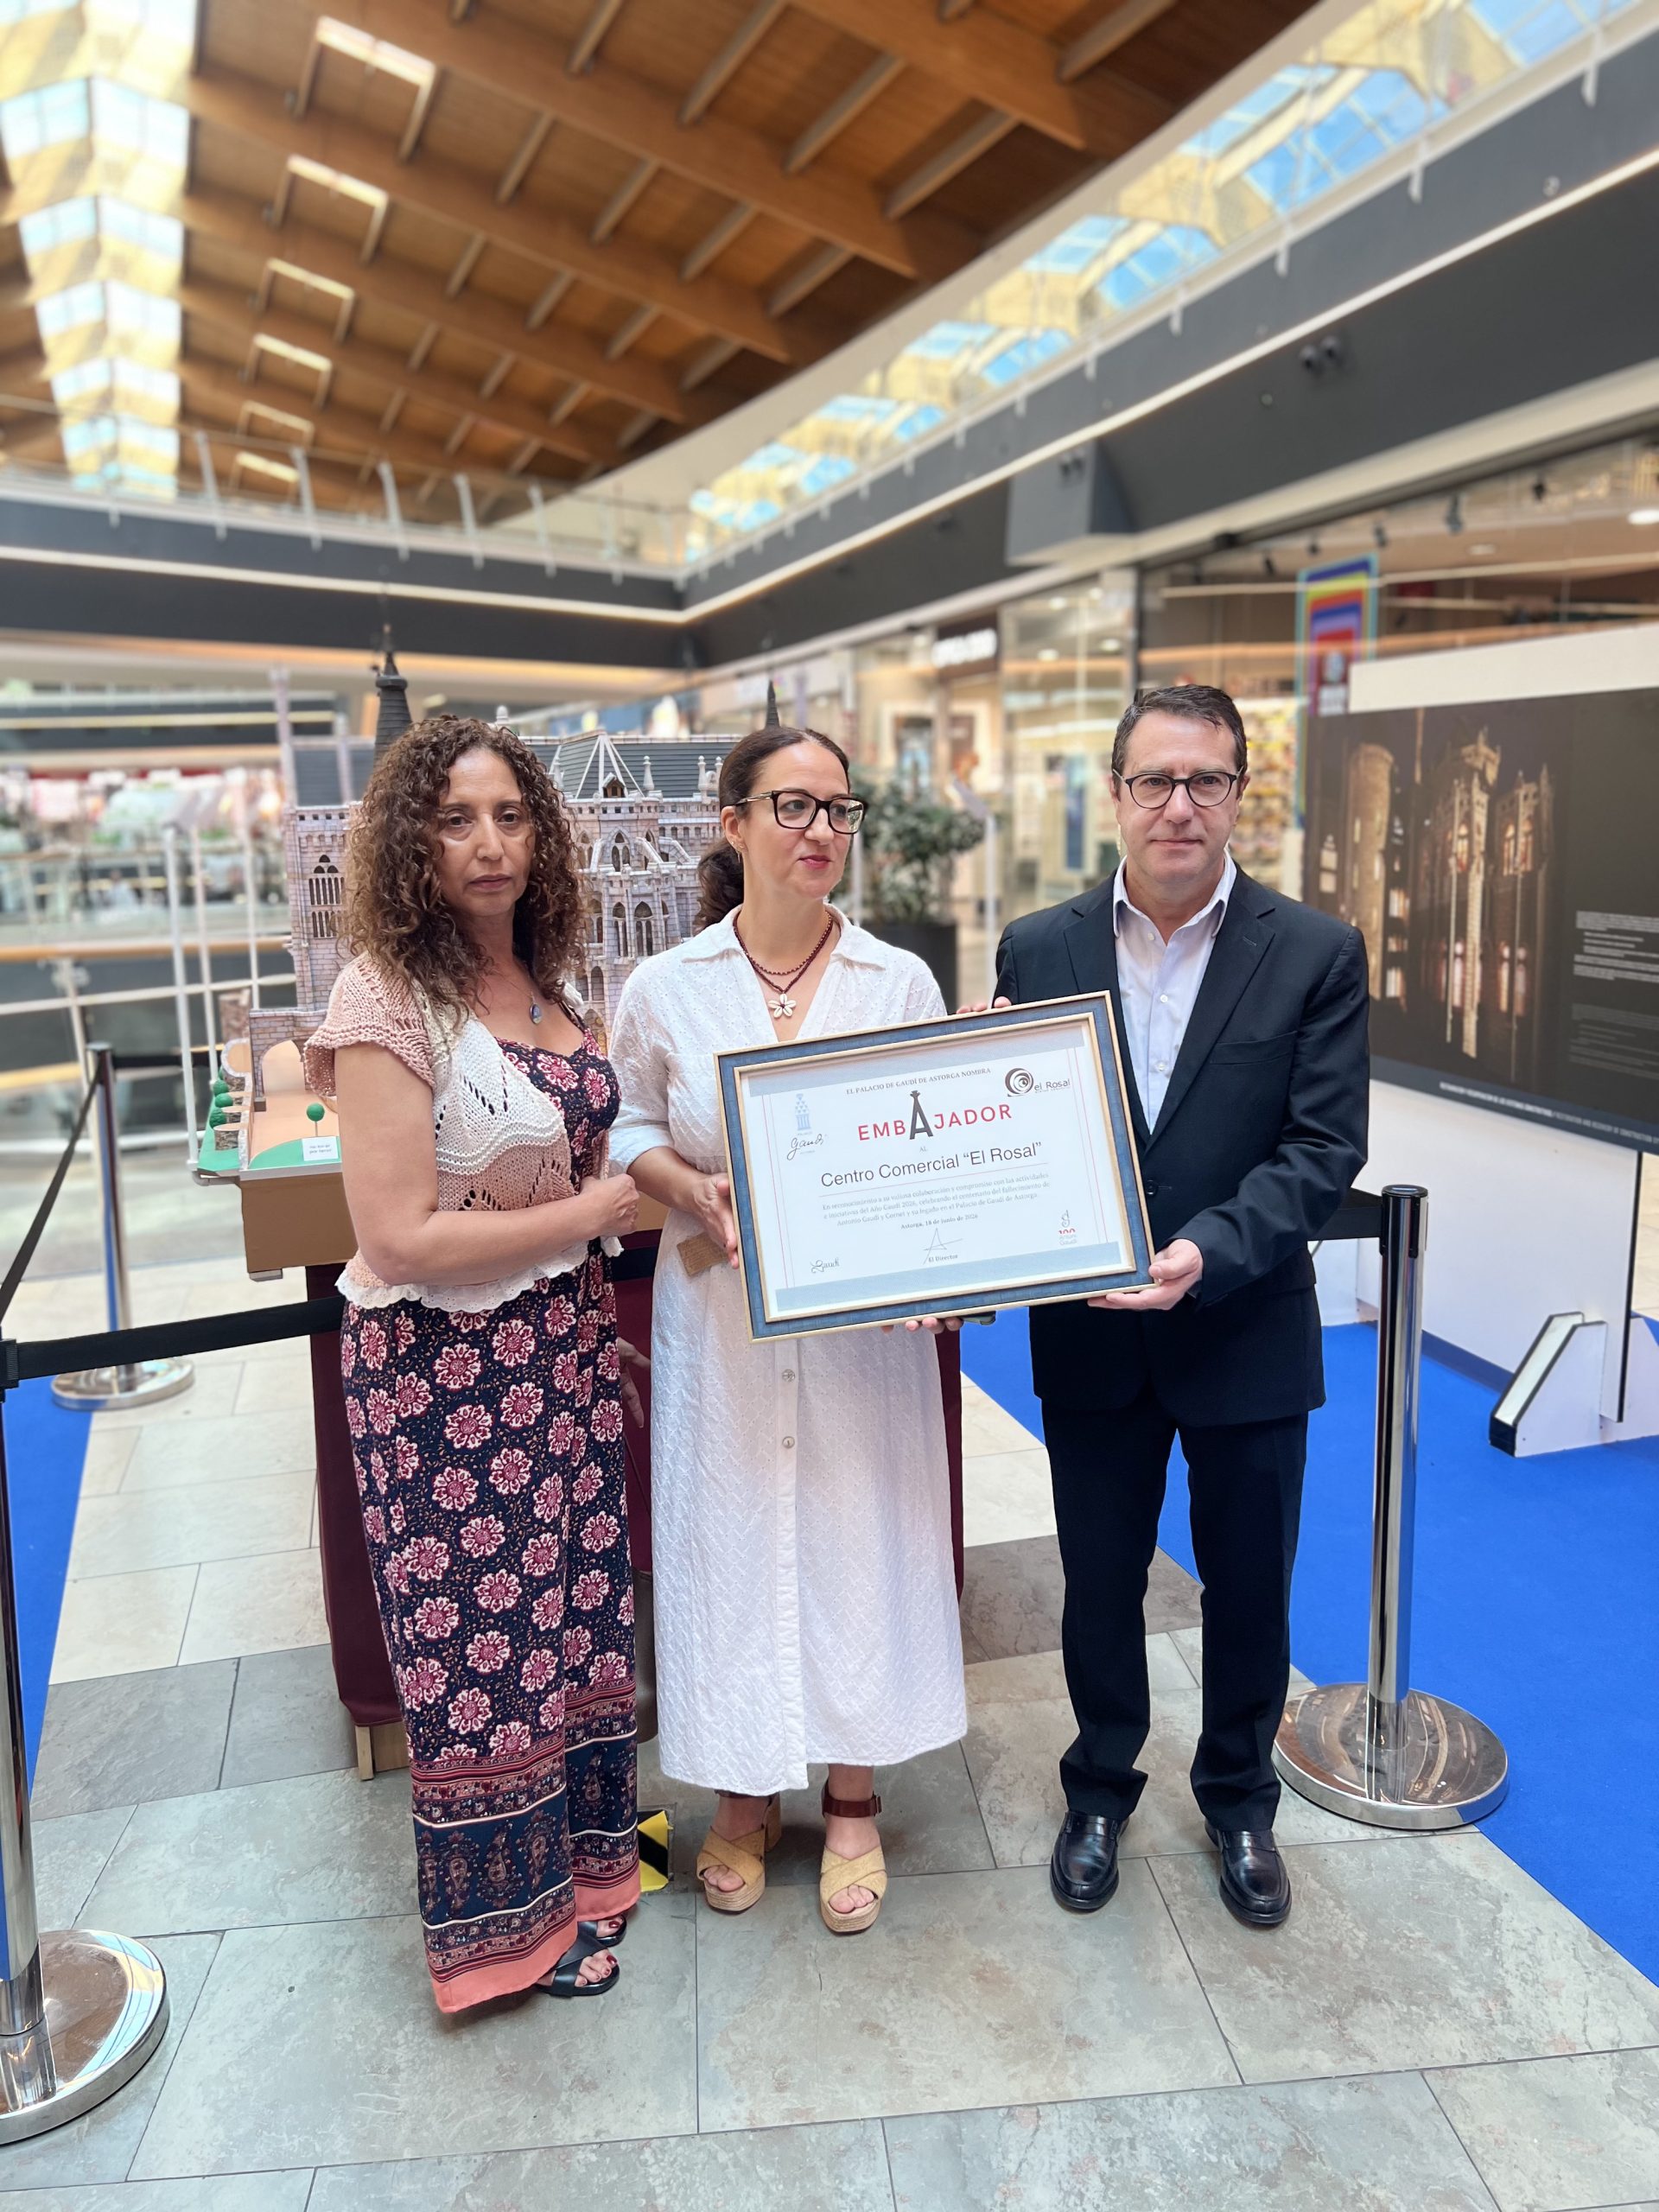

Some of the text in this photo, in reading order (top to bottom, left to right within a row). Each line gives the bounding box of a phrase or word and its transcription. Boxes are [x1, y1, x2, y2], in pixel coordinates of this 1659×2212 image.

[855, 1084, 885, 1094] PALACIO
[895, 1077, 918, 1087] GAUDÍ
[928, 1072, 960, 1083] ASTORGA
[961, 1067, 991, 1077] NOMBRA
[1034, 1082, 1042, 1091] el
[1046, 1078, 1071, 1089] Rosal
[858, 1090, 1012, 1141] EMBAJADOR
[821, 1167, 874, 1187] Centro
[879, 1154, 959, 1179] Comercial
[829, 1209, 859, 1218] iniciativas
[919, 1196, 951, 1205] celebrando
[1002, 1183, 1042, 1193] fallecimiento
[831, 1198, 877, 1210] reconocimiento
[956, 1180, 993, 1191] compromiso
[1015, 1173, 1049, 1182] actividades
[836, 1217, 861, 1226] Antonio
